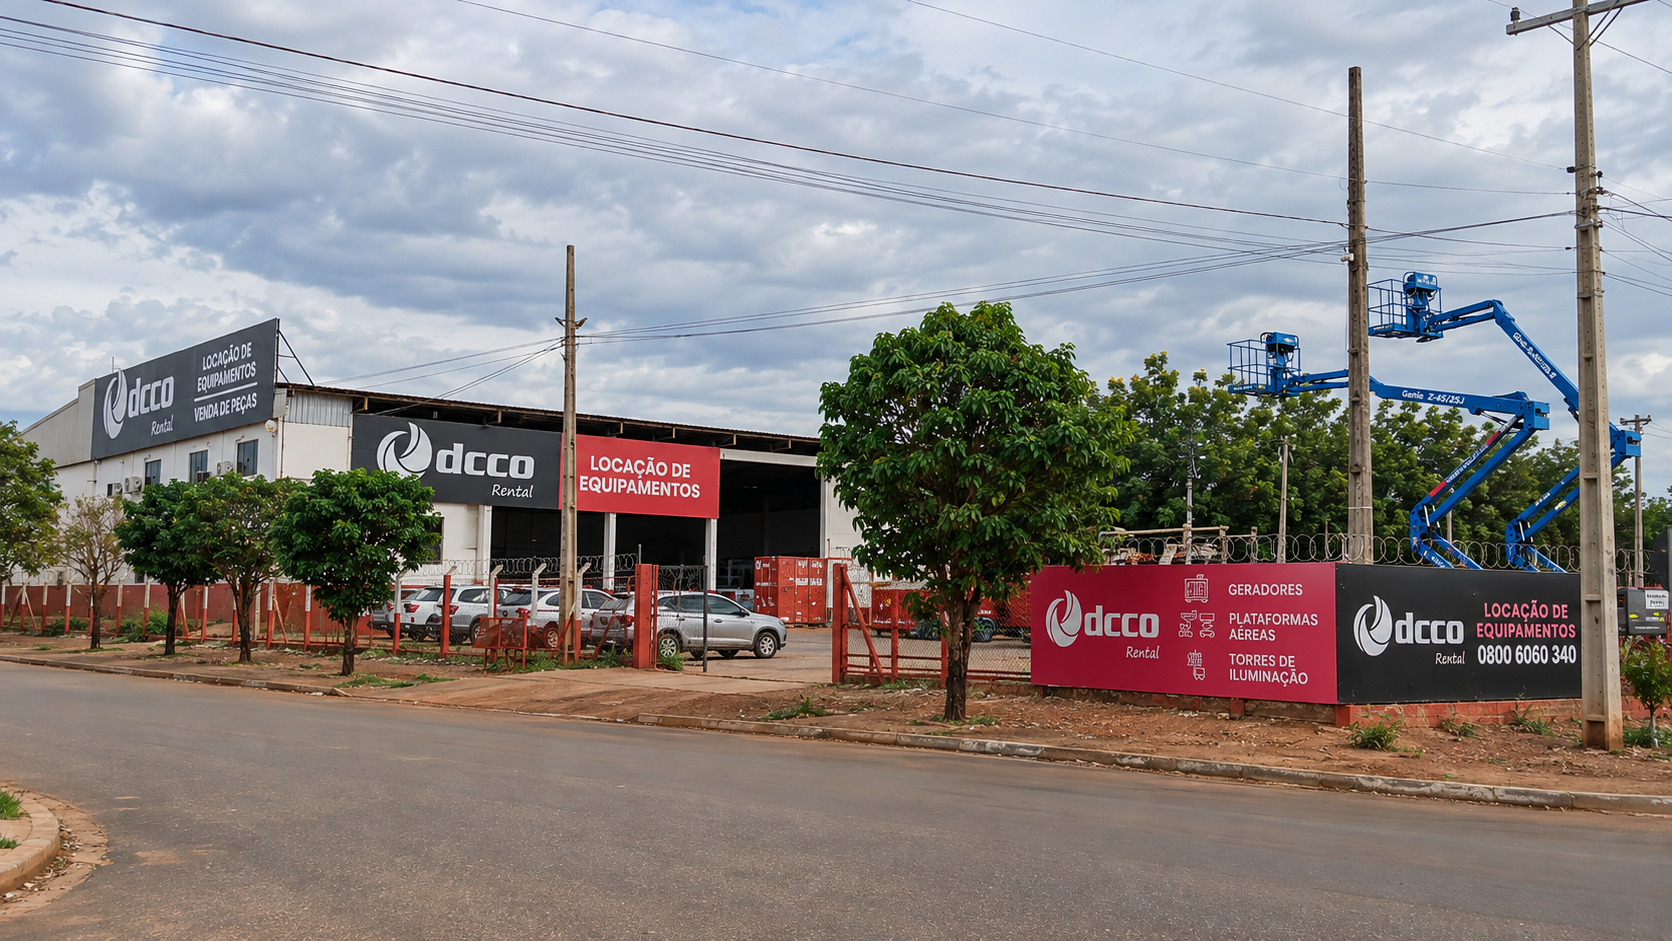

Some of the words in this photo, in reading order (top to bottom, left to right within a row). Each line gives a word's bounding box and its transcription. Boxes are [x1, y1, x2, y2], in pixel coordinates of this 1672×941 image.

[202, 344, 240, 371] LOCAÇÃO
[241, 341, 252, 360] DE
[197, 361, 256, 394] EQUIPAMENTOS
[128, 376, 174, 418] dcco
[194, 402, 219, 422] VENDA
[219, 399, 230, 416] DE
[230, 392, 257, 415] PEÇAS
[150, 414, 174, 436] Rental
[435, 442, 535, 480] dcco
[590, 455, 668, 479] LOCAÇÃO
[671, 462, 691, 479] DE
[491, 483, 534, 498] Rental
[579, 475, 700, 499] EQUIPAMENTOS
[1228, 583, 1303, 596] GERADORES
[1084, 605, 1160, 638] dcco
[1229, 612, 1318, 626] PLATAFORMAS
[1484, 599, 1549, 622] LOCAÇÃO
[1552, 603, 1569, 619] DE
[1229, 625, 1276, 641] AÉREAS
[1395, 612, 1464, 644] dcco
[1476, 622, 1576, 640] EQUIPAMENTOS
[1125, 645, 1160, 659] Rental
[1228, 653, 1276, 667] TORRES
[1279, 655, 1295, 668] DE
[1435, 650, 1466, 665] Rental
[1477, 644, 1512, 665] 0800
[1515, 644, 1549, 665] 6060
[1551, 644, 1577, 665] 340
[1229, 668, 1308, 687] ILUMINAÇÃO
